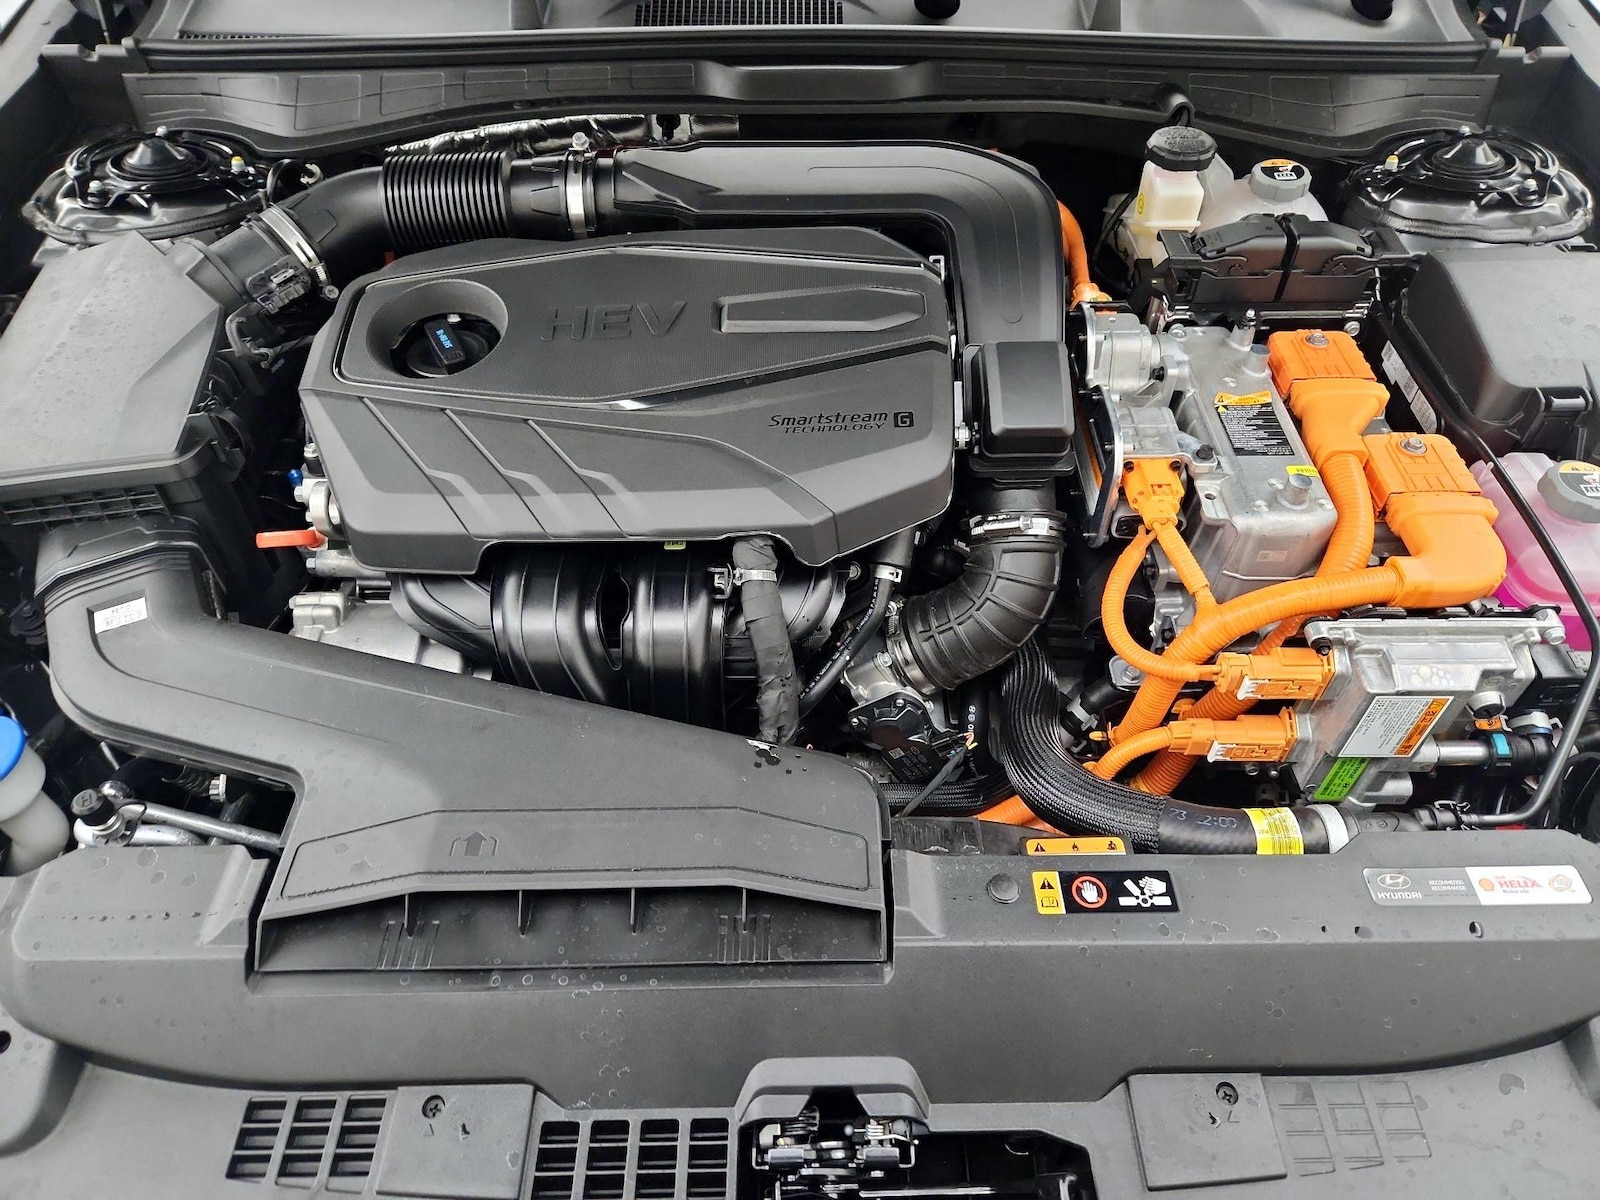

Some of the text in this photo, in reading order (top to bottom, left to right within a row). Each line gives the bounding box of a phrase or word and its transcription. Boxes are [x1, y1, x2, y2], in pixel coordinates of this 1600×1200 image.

[541, 300, 688, 341] HEV
[768, 411, 911, 427] Smartstream G
[785, 422, 885, 434] TECHNOLOGY
[1498, 879, 1542, 888] HELIX
[1377, 891, 1422, 900] HYUNDAI
